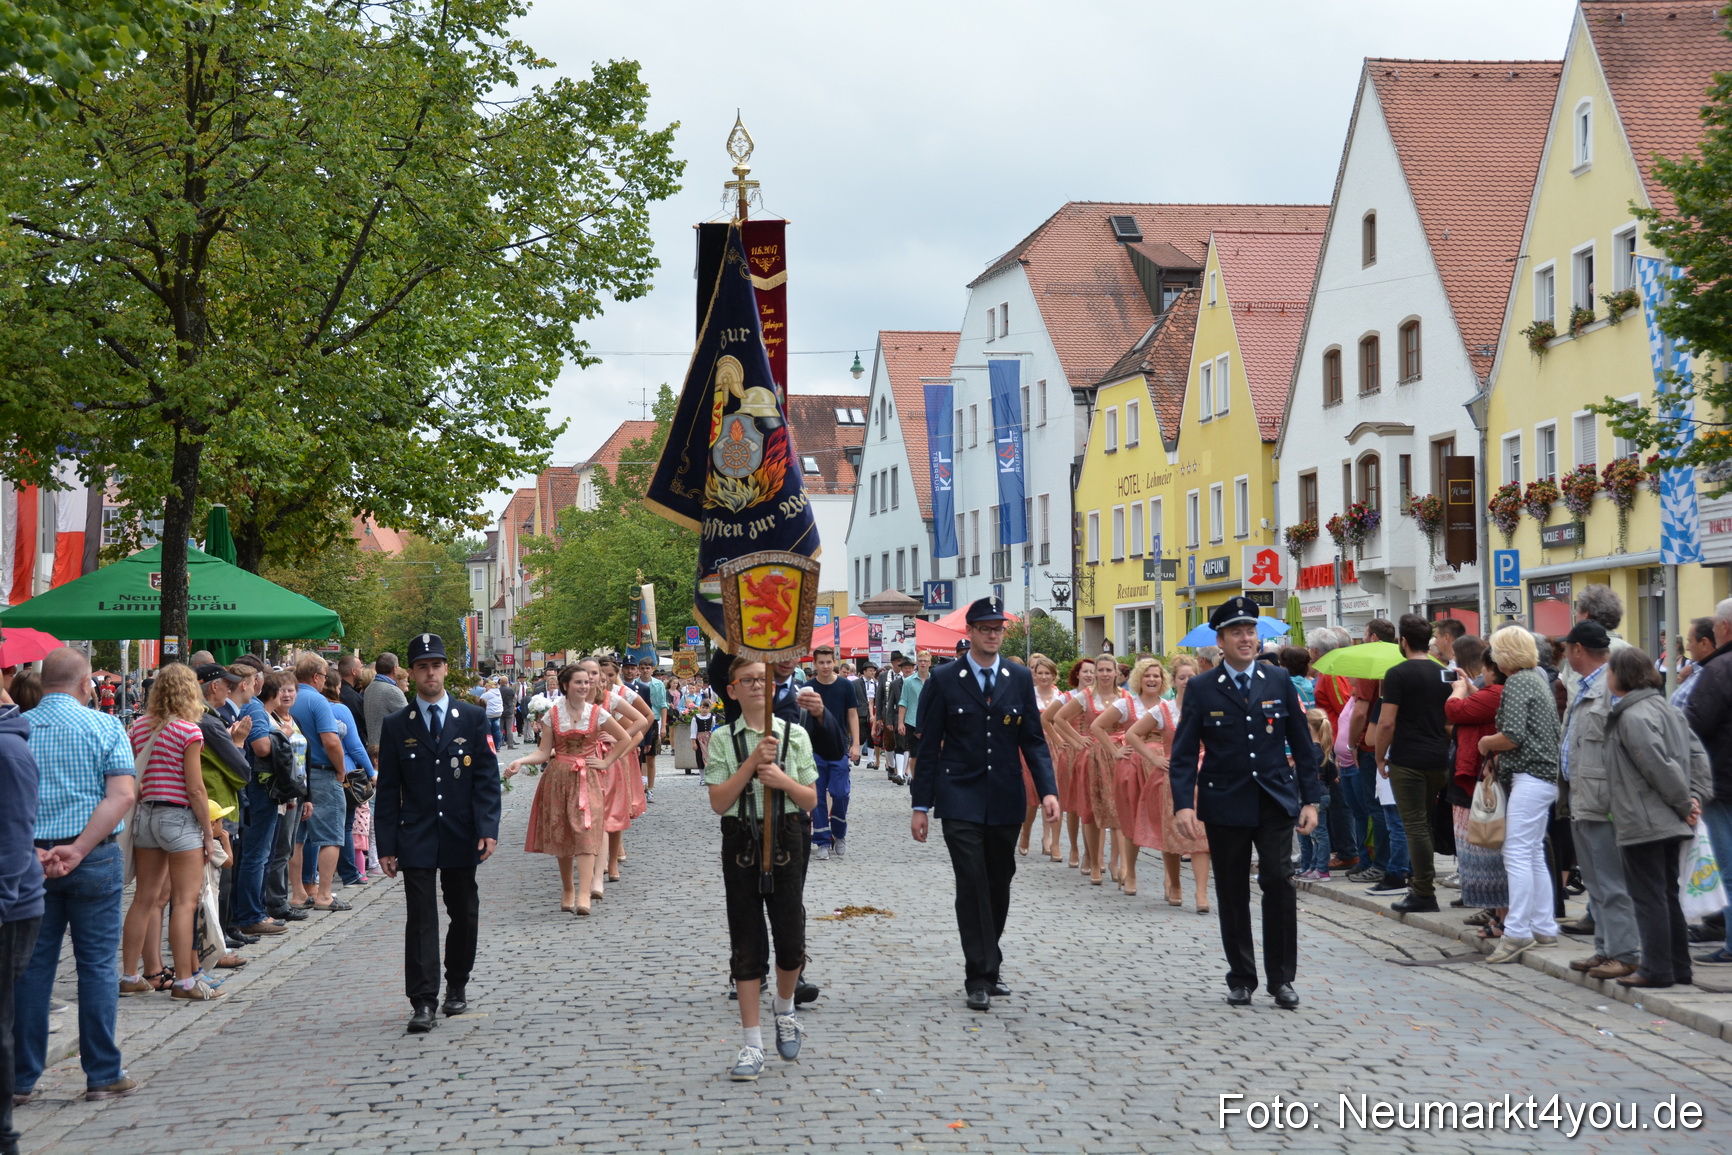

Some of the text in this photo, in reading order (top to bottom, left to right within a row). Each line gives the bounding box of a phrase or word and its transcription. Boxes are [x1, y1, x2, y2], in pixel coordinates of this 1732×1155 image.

[719, 326, 751, 350] zur
[998, 430, 1015, 473] K&L
[1117, 469, 1173, 498] HOTEL Lehmeier
[748, 514, 776, 540] zur
[1542, 530, 1559, 543] WOLLE
[1201, 559, 1224, 576] TAIFUN
[1500, 554, 1514, 583] P
[1117, 583, 1149, 600] Restaurant
[1531, 583, 1550, 597] WOLLE
[1555, 580, 1570, 595] MEHR
[98, 601, 237, 611] Lammbräu
